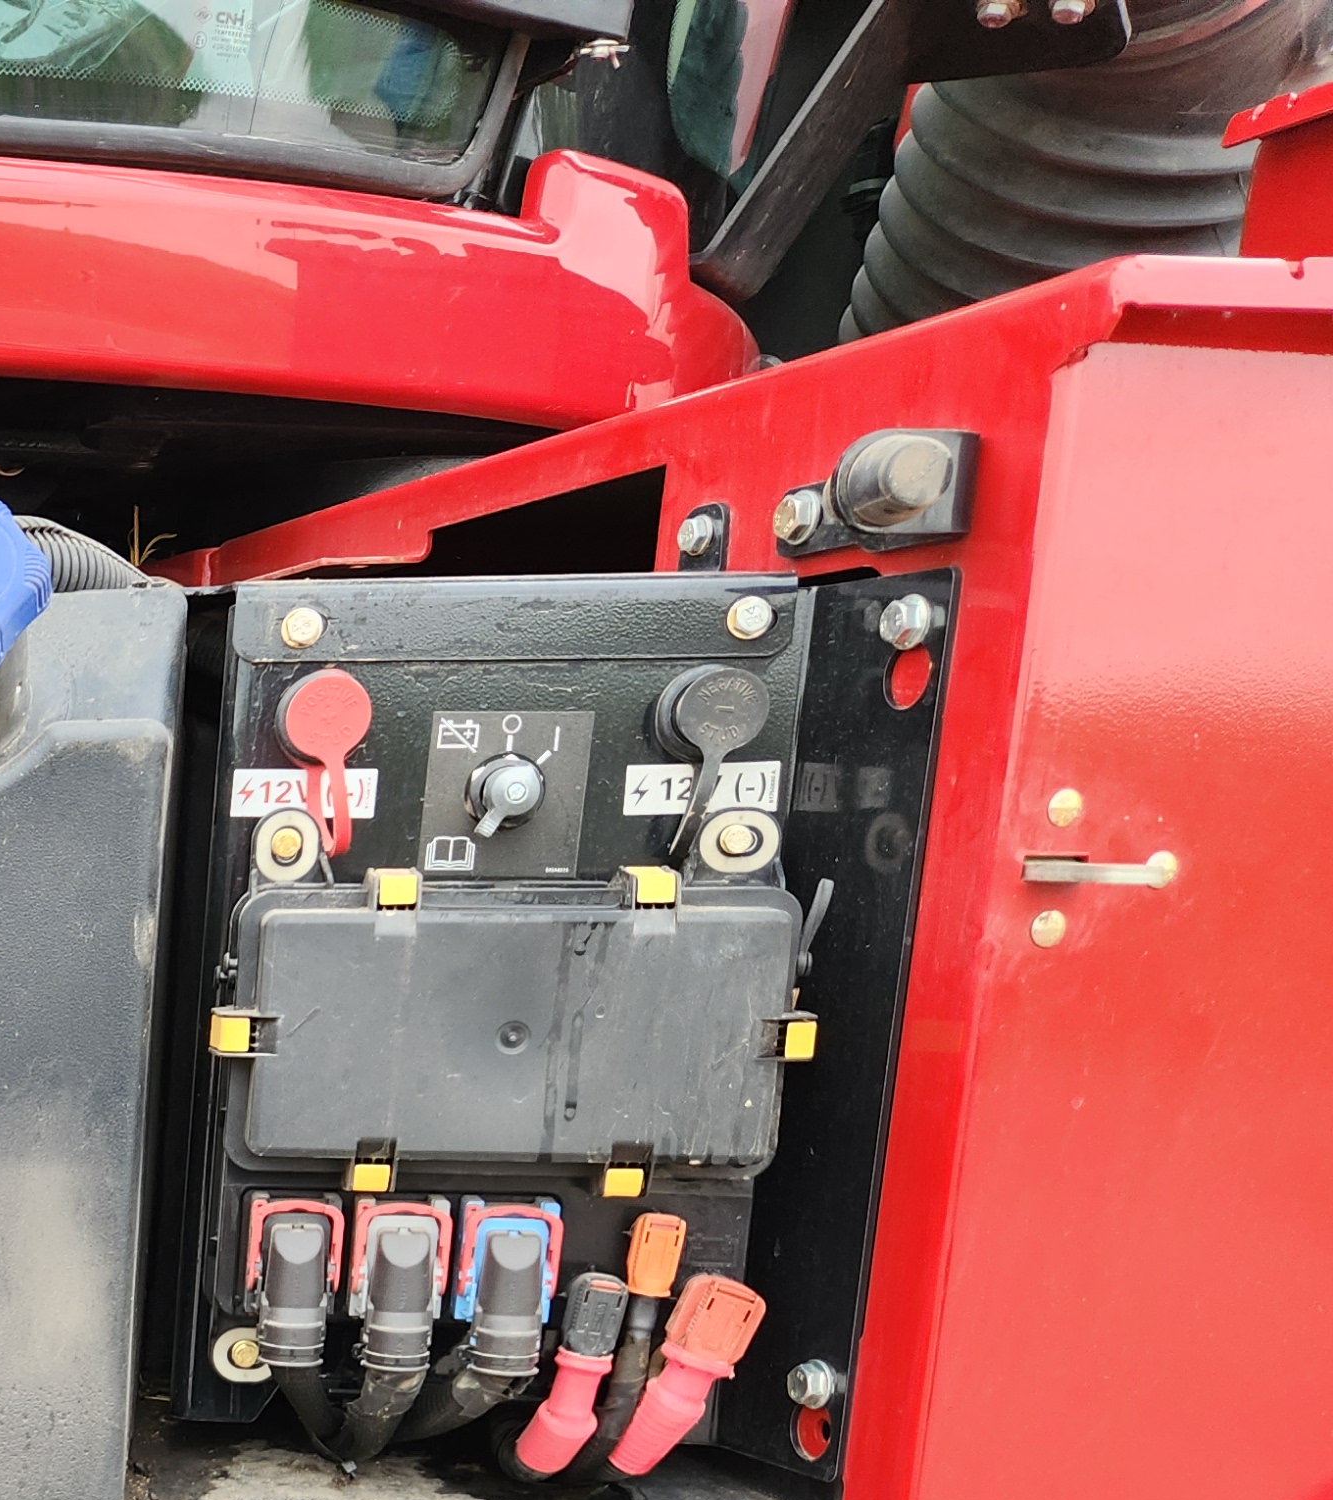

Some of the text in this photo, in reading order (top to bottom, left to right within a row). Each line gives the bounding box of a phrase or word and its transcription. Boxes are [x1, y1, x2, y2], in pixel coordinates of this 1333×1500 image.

[215, 9, 245, 26] CNH
[300, 684, 358, 717] POSITIVE
[697, 677, 760, 705] NEGATIVE
[307, 723, 353, 747] STUD
[699, 721, 740, 742] STUD
